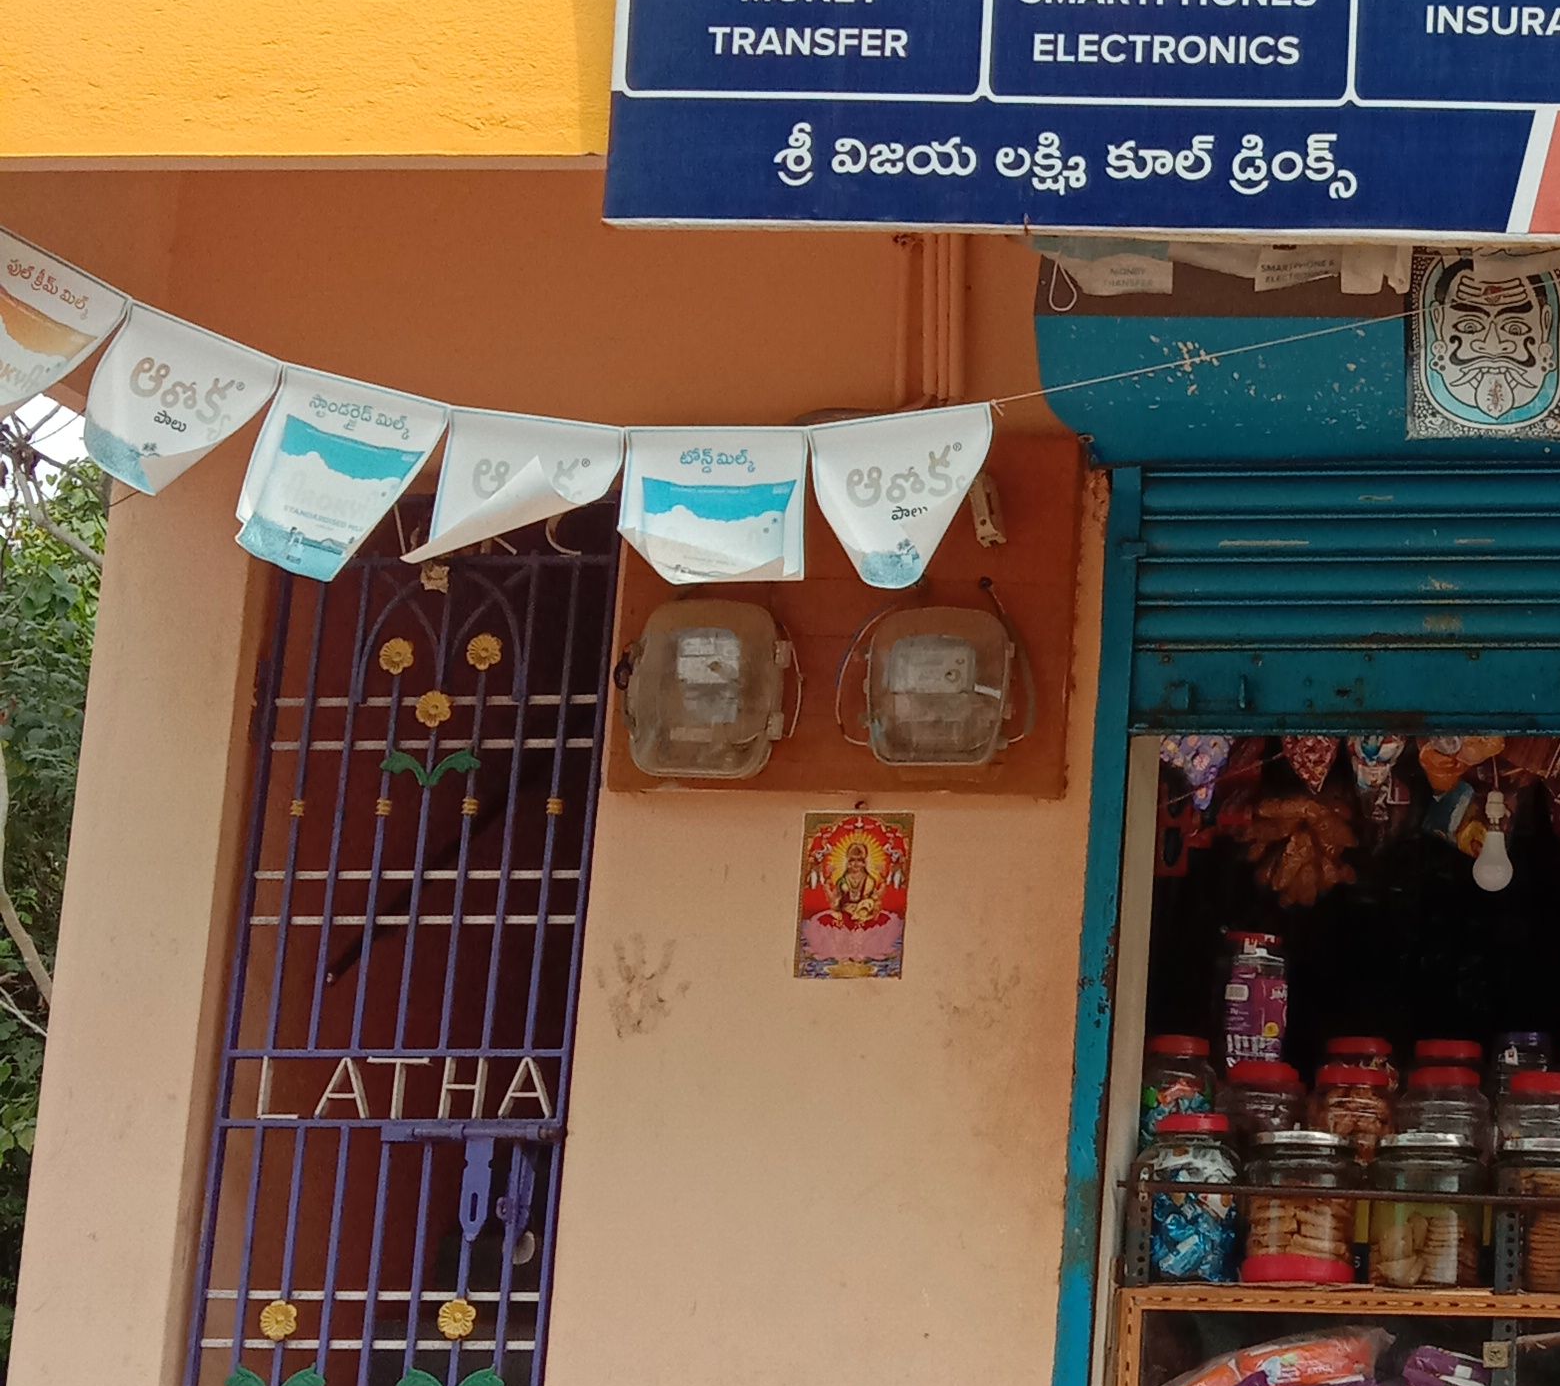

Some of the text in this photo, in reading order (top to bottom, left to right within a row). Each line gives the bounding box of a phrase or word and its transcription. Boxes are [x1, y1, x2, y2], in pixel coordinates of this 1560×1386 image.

[708, 26, 908, 58] TRANSFER
[1033, 33, 1300, 65] ELECTRONICS
[771, 121, 1358, 199] శ్రీ విజయ లక్ష్మి కూల్ డ్రింక్స్
[153, 409, 188, 433] పాలు
[256, 1055, 555, 1121] LATHA
